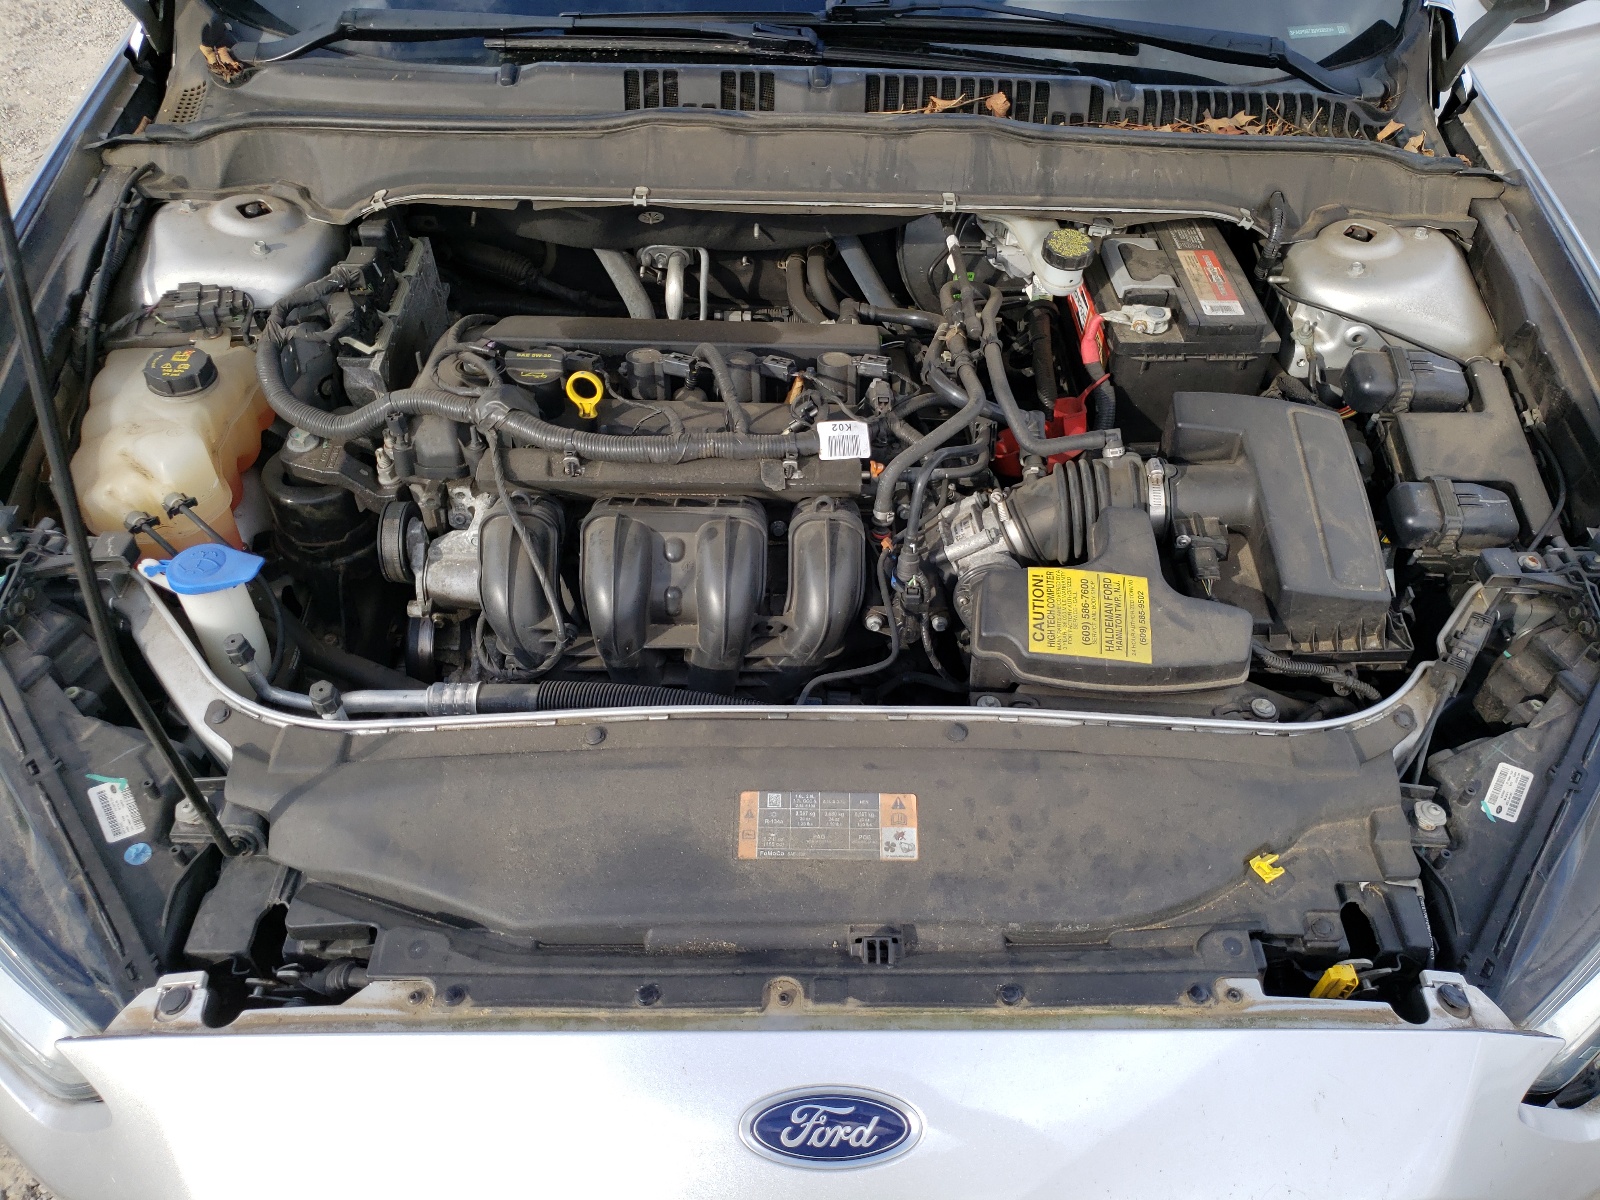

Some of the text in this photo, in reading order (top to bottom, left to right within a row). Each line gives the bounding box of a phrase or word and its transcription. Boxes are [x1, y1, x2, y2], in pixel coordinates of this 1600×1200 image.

[832, 424, 852, 432] K02
[1032, 574, 1045, 642] CAUTION!
[1046, 571, 1055, 647] HIGH TECH COMPUTER
[1080, 579, 1092, 645] (609) 586-7600
[1103, 578, 1114, 652] HALDEMAN FORD
[1139, 626, 1147, 645] (609)
[780, 1104, 880, 1148] Ford
